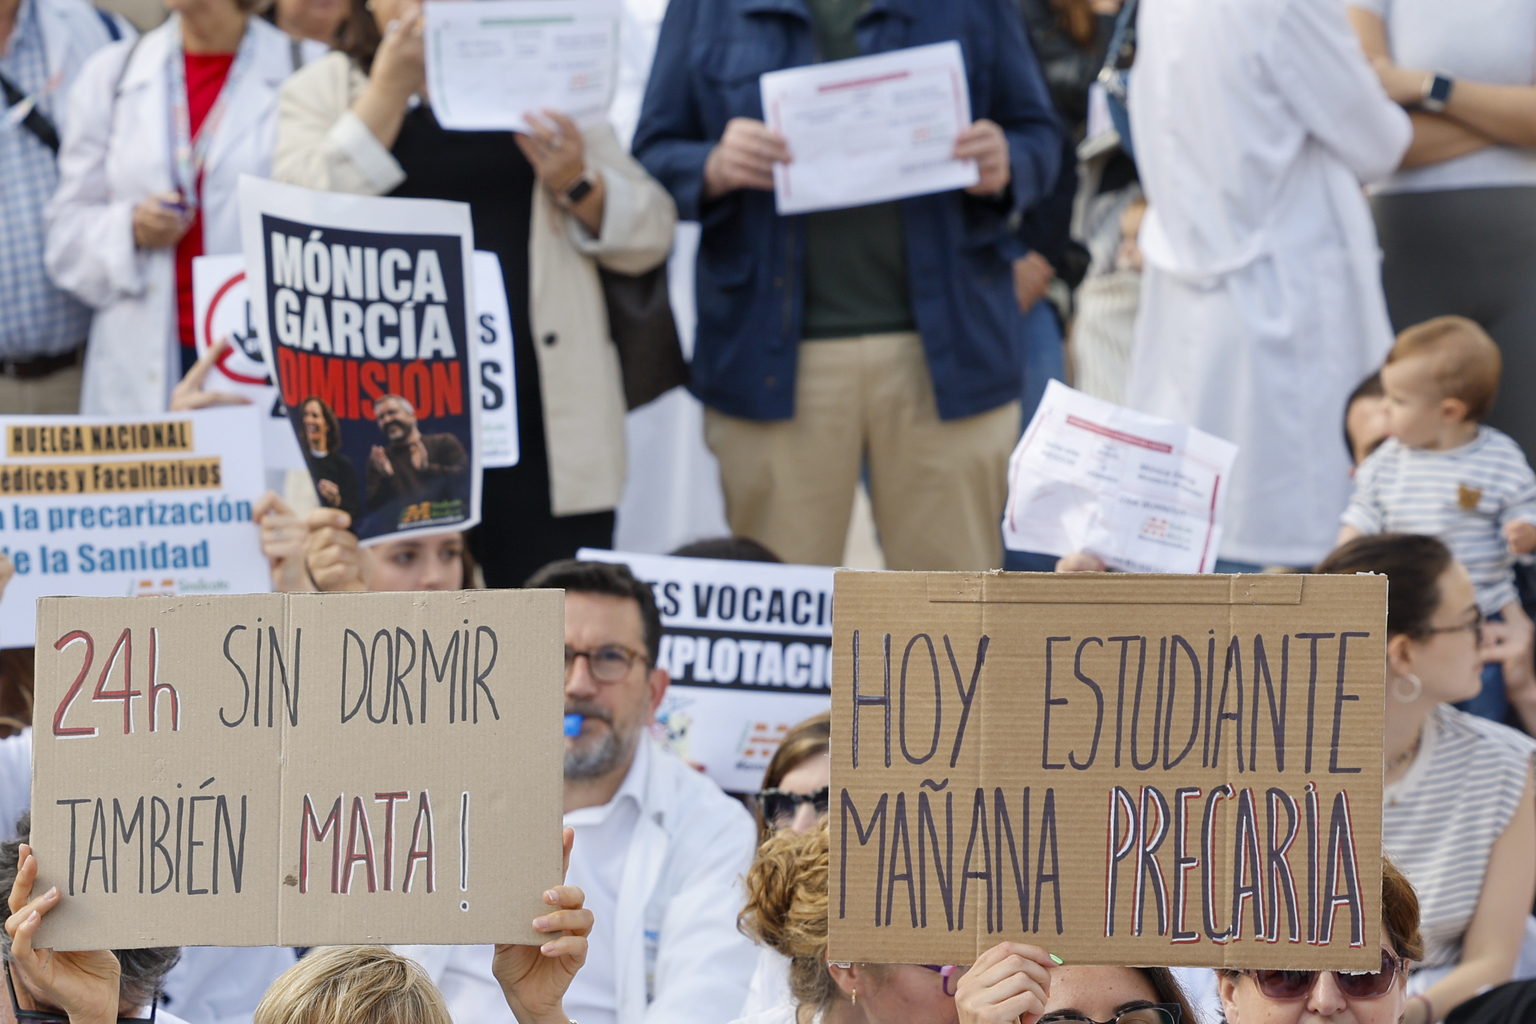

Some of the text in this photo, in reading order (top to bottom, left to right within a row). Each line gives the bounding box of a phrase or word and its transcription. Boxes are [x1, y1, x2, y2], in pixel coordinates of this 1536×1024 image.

[271, 230, 448, 303] MÓNICA
[274, 288, 457, 360] GARCÍA
[277, 346, 463, 420] DIMISIÓN
[13, 422, 189, 452] HUELGA NACIONAL
[75, 469, 86, 493] y
[92, 457, 221, 489] Facultativos
[14, 504, 40, 531] la
[48, 495, 253, 533] precarización
[41, 545, 69, 574] la
[79, 540, 210, 575] Sanidad
[694, 584, 833, 627] VOCACI
[52, 618, 500, 739] 24h SIN DORMIR
[852, 629, 1370, 774] HOY ESTUDIANTE
[57, 778, 247, 896] TAMBIÉN
[839, 778, 1365, 949] MAÑANA PRECARIA
